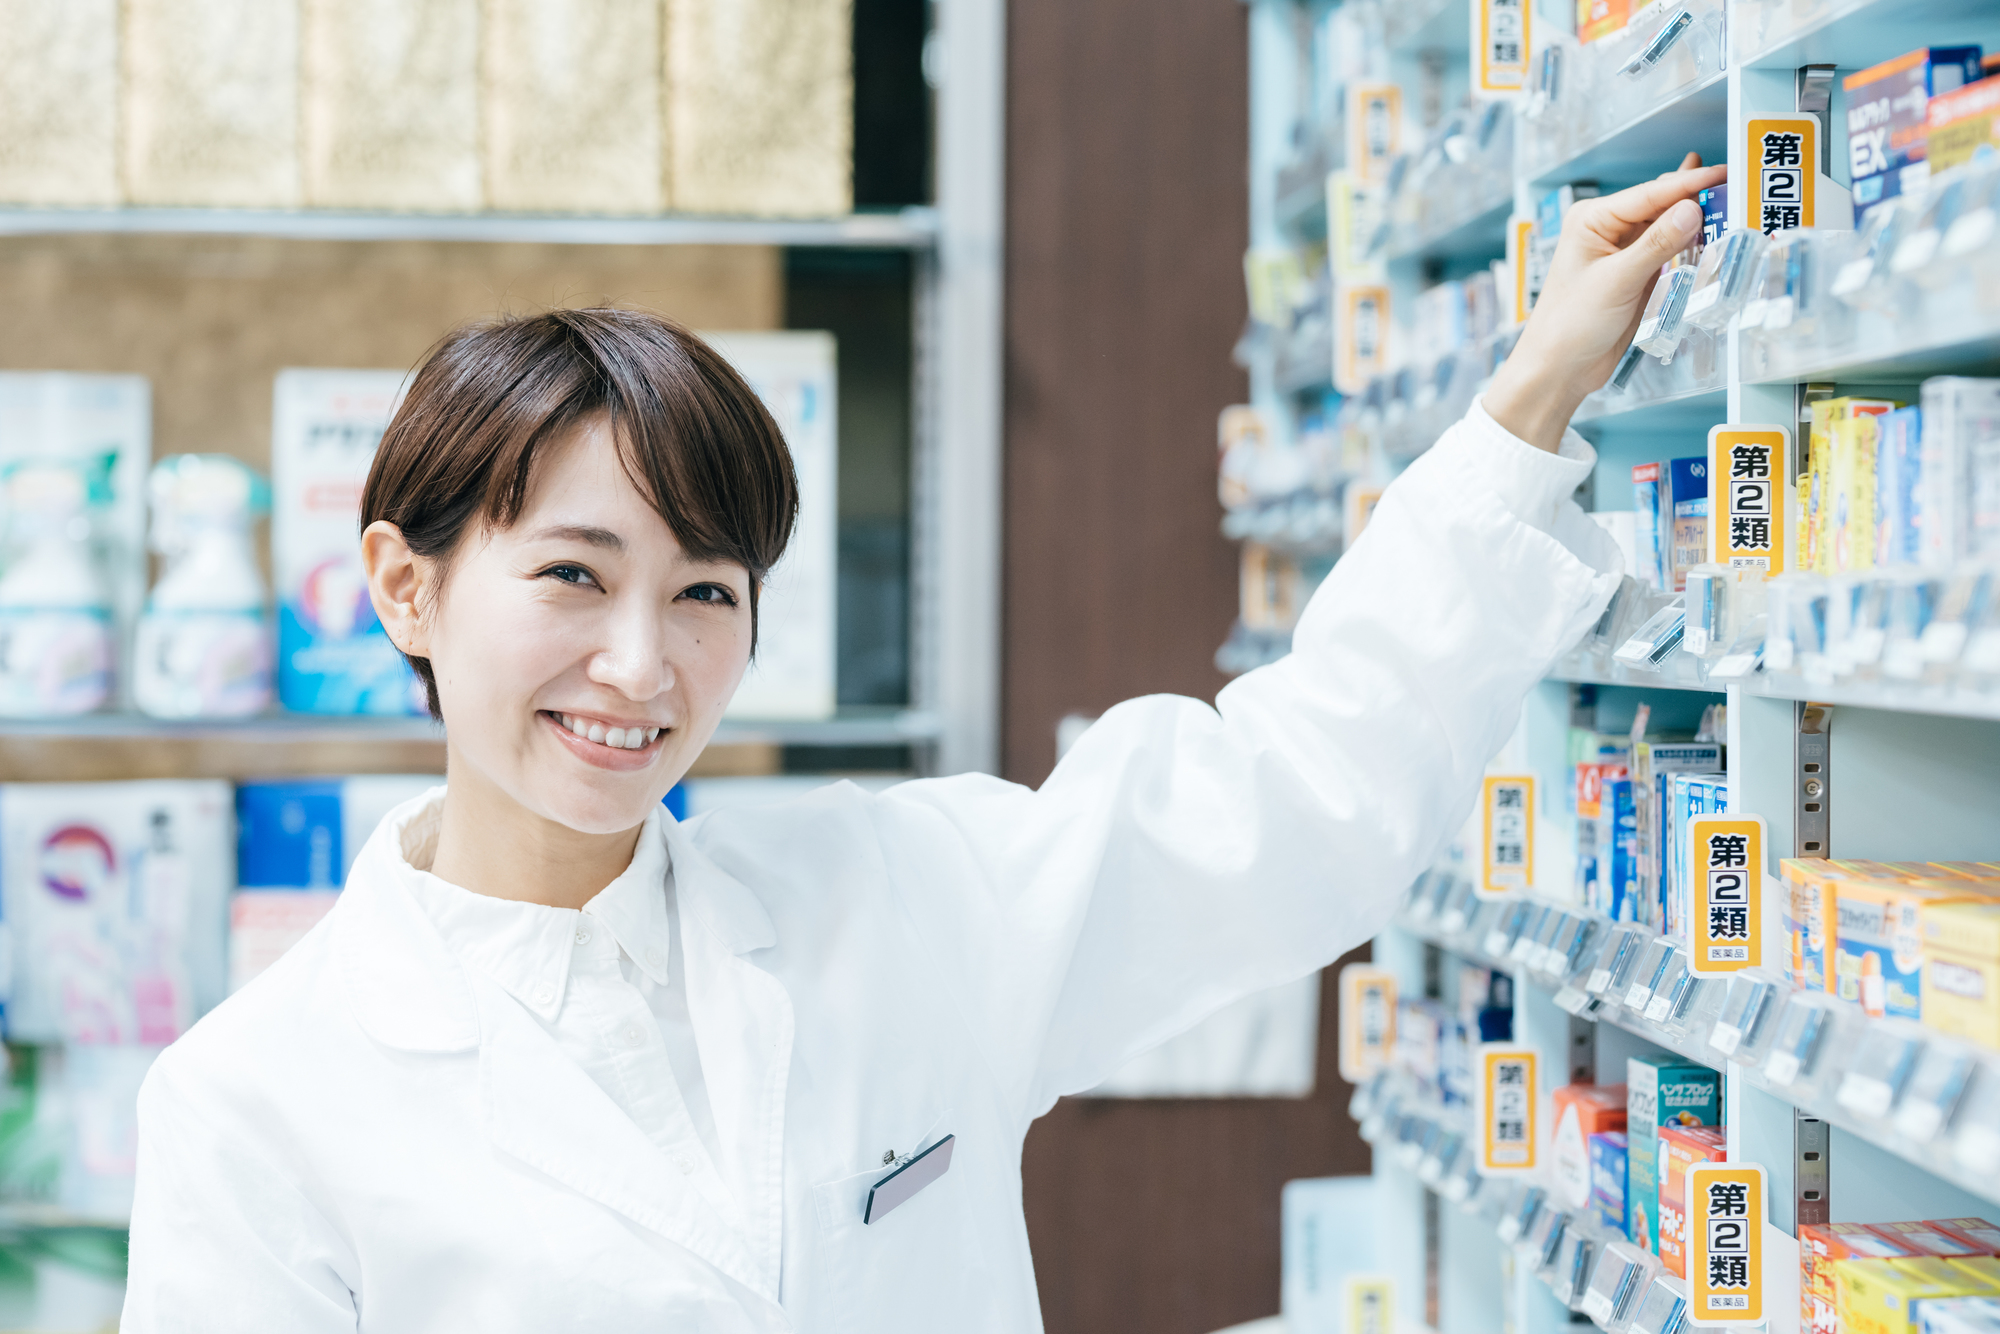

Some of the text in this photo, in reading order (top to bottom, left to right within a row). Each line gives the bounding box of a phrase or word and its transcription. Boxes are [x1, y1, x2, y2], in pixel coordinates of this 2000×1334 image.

[1763, 133, 1801, 236] 第2類
[1849, 126, 1888, 179] EX
[1731, 446, 1770, 549] 第2類
[1710, 835, 1748, 939] 第2類
[1712, 949, 1745, 959] 医薬品
[1710, 1184, 1748, 1287] 第2類
[1712, 1298, 1745, 1307] 医薬品
